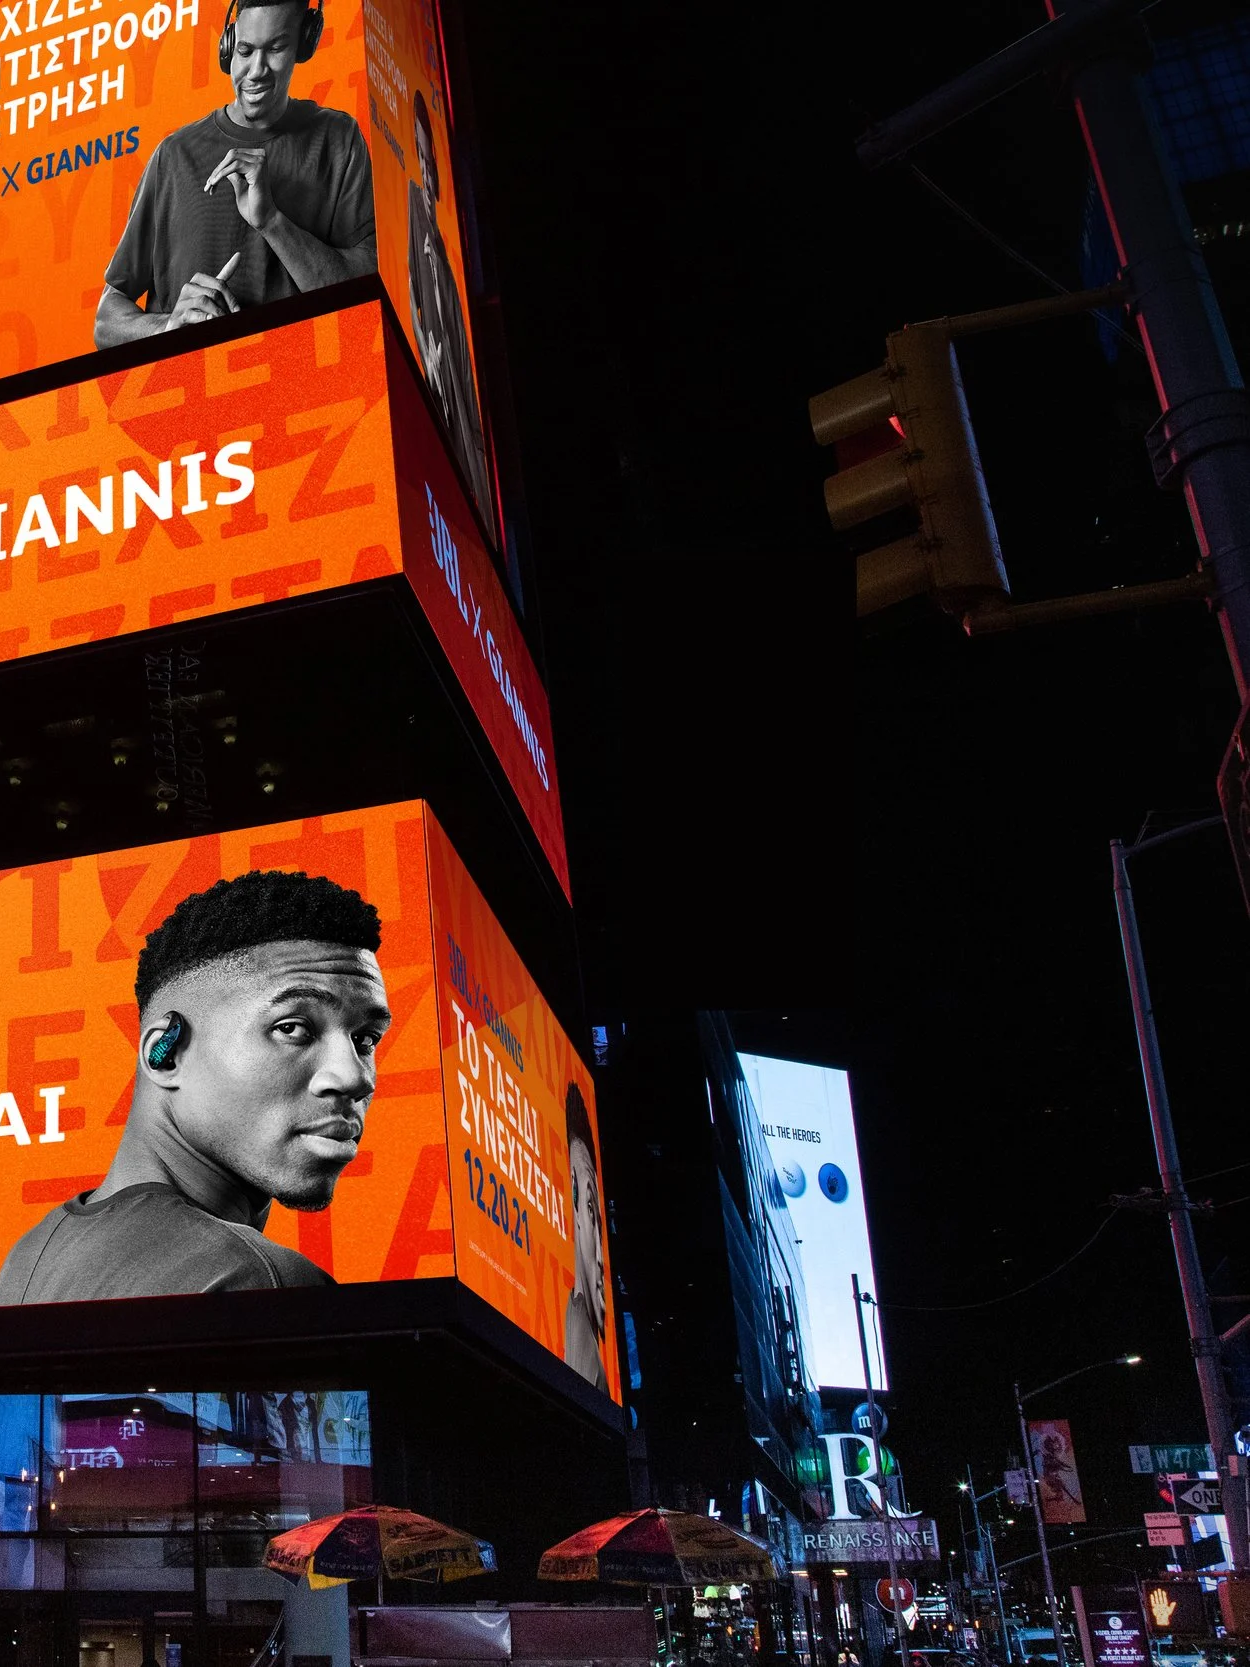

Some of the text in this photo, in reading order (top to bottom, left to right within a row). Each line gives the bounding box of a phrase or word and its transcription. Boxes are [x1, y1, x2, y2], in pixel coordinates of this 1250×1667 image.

[1, 161, 21, 197] X
[26, 125, 139, 185] GIANNIS
[424, 480, 470, 626] JBL
[485, 629, 549, 792] GIANNIS
[776, 1125, 791, 1140] THE
[792, 1127, 822, 1144] HEROES
[464, 1147, 530, 1257] 12.20.21
[817, 1432, 923, 1521] R
[1155, 1449, 1169, 1469] W
[1173, 1447, 1190, 1469] 47
